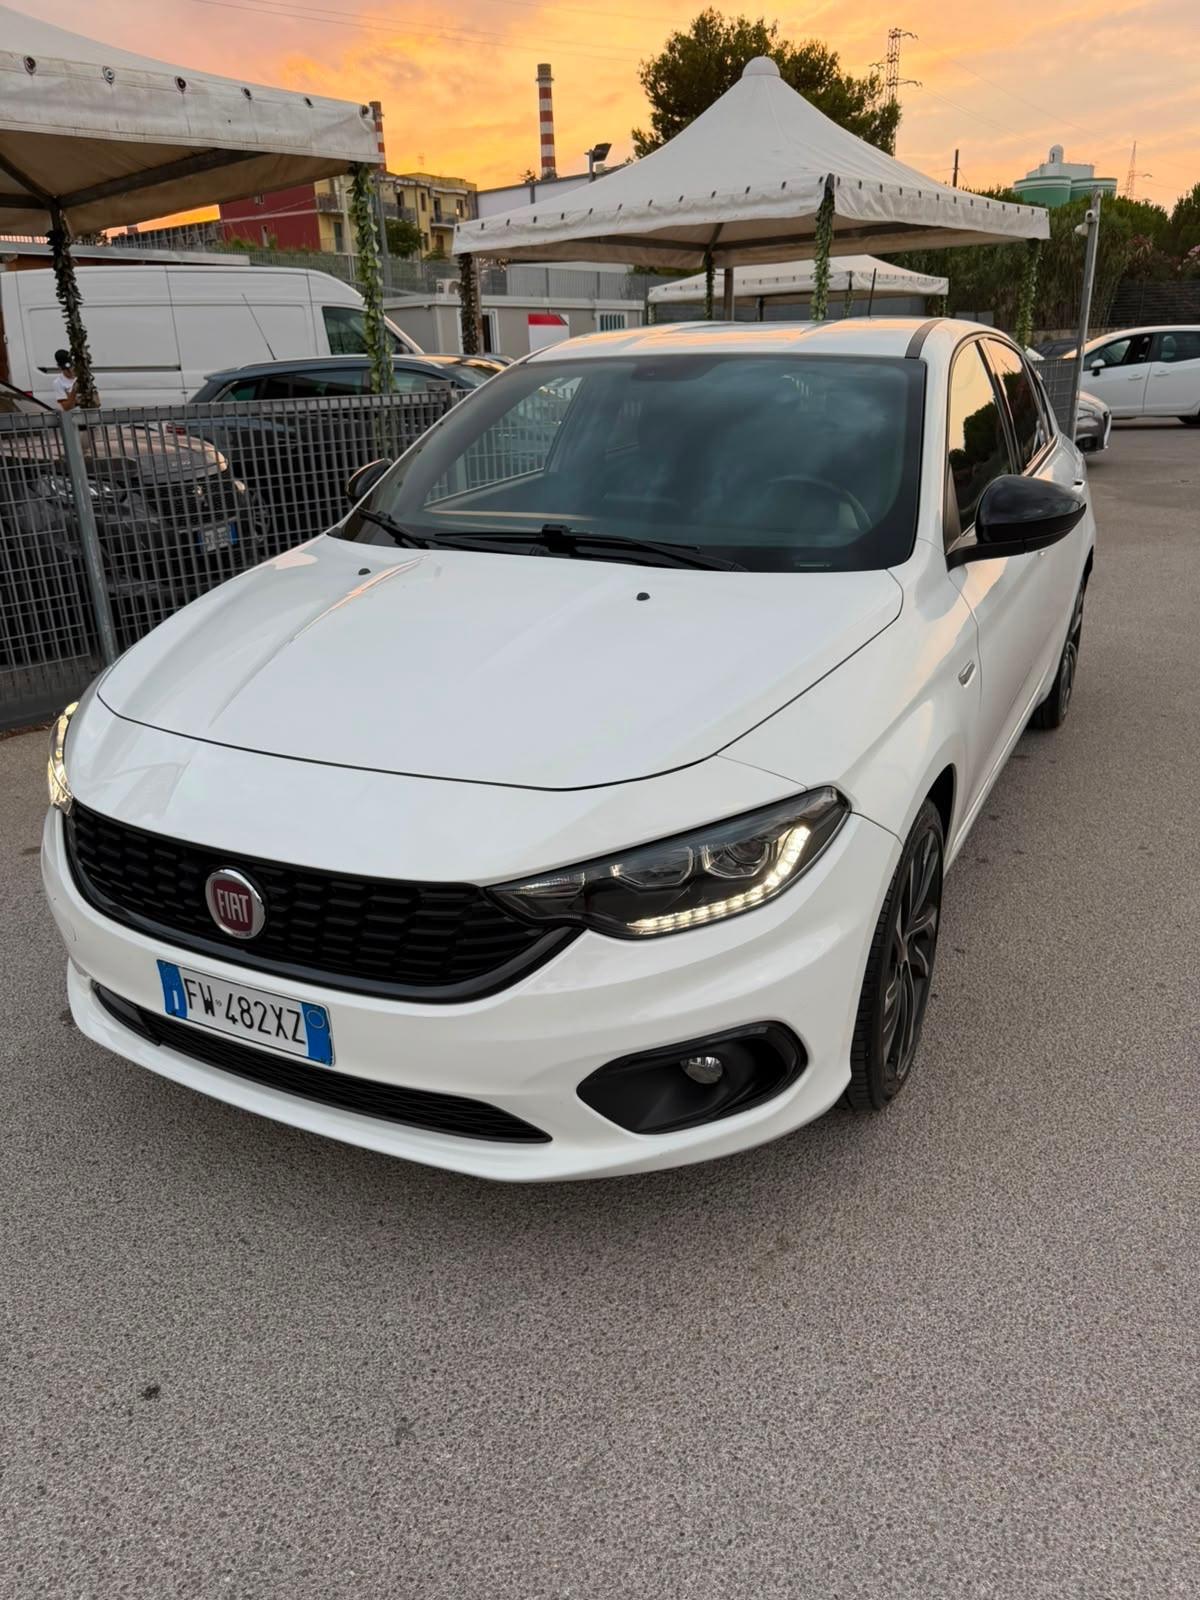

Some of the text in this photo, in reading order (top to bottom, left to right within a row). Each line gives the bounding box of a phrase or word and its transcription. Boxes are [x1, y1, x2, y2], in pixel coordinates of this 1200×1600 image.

[216, 888, 249, 924] FIAT
[183, 978, 306, 1045] FW 482XZ
